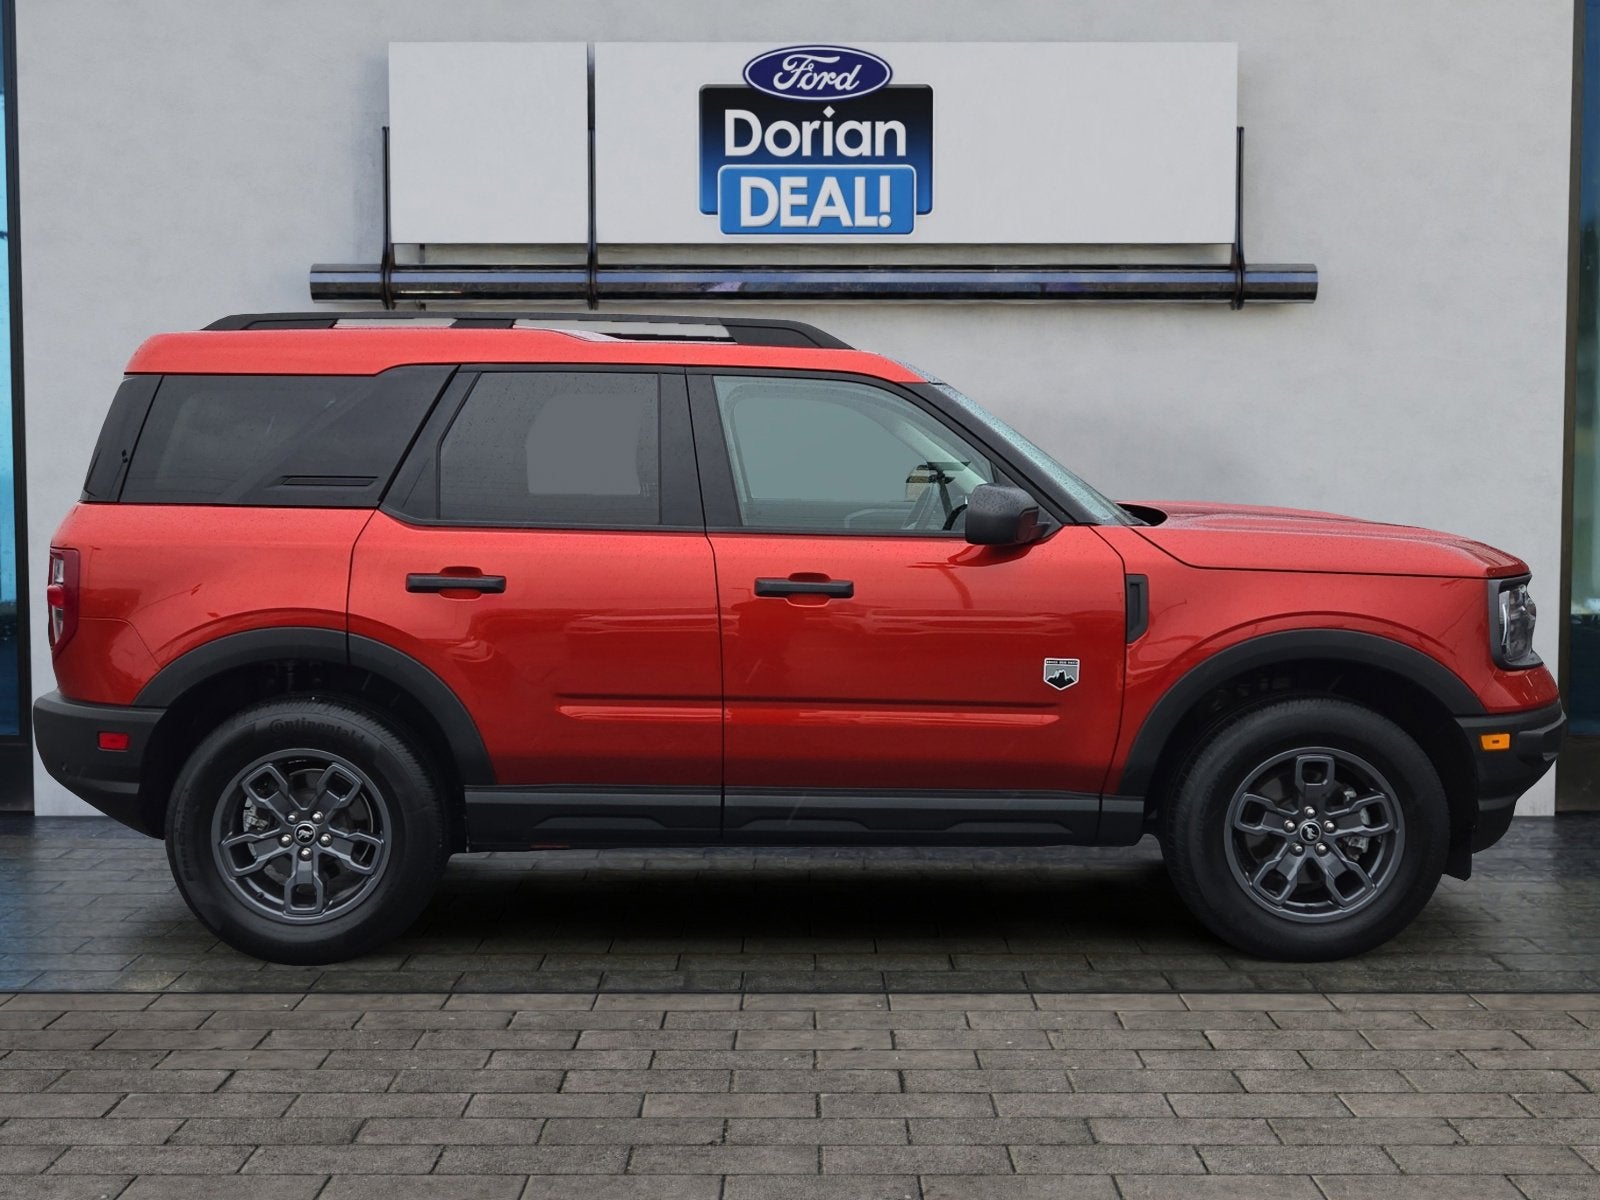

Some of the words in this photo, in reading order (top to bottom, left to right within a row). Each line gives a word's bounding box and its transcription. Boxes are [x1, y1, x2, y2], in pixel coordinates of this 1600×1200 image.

[773, 54, 862, 90] Ford
[725, 105, 906, 157] Dorian
[740, 175, 892, 228] DEAL!
